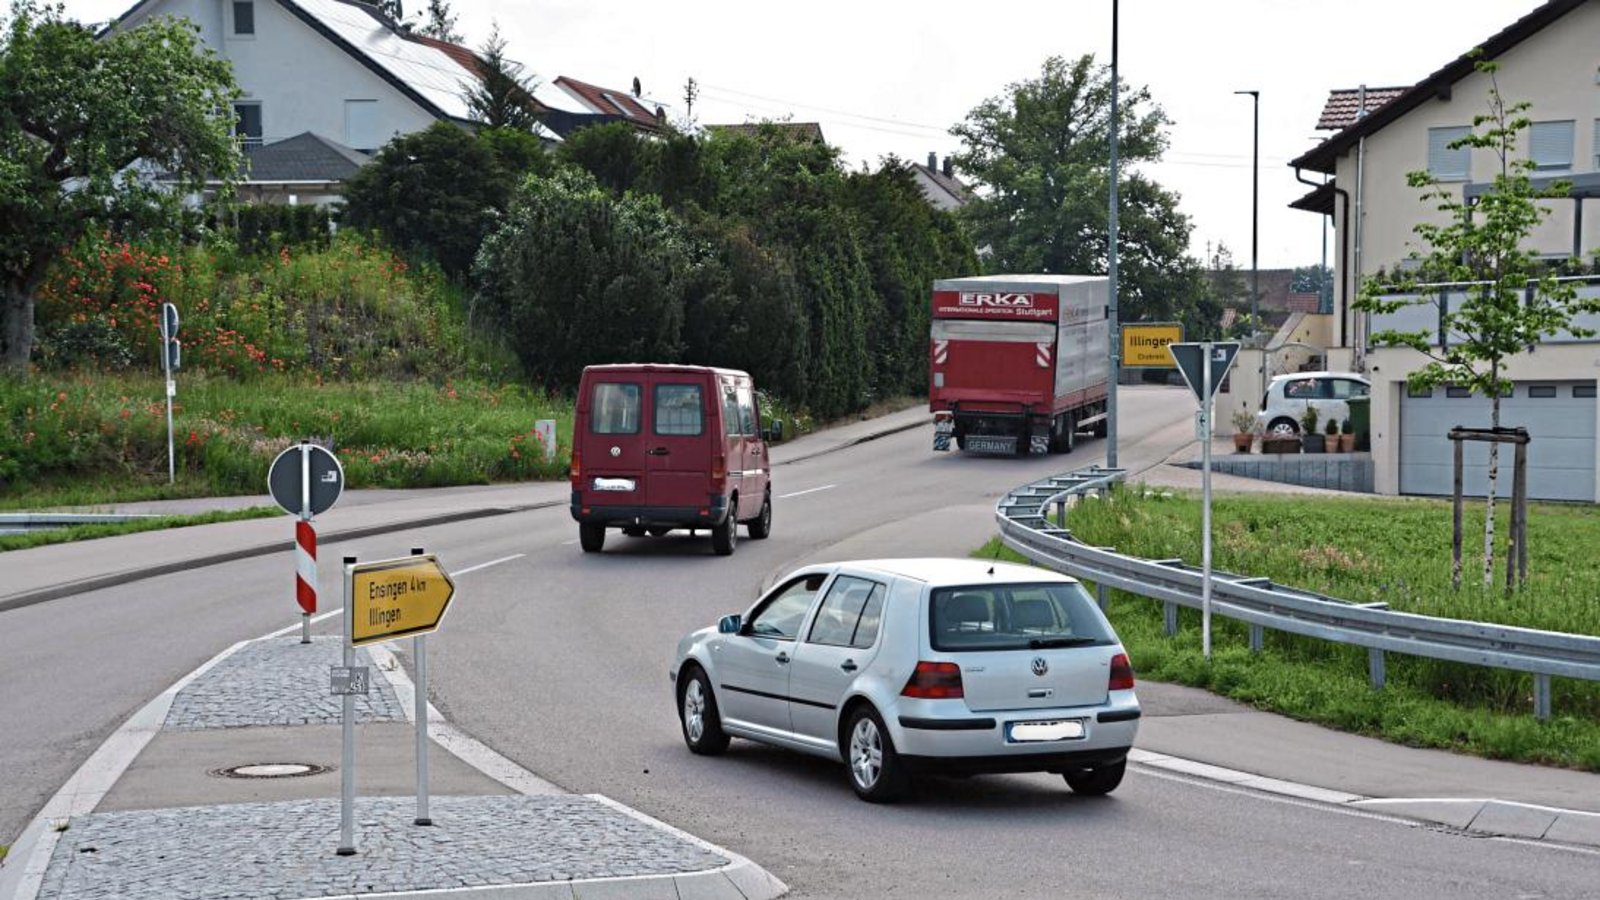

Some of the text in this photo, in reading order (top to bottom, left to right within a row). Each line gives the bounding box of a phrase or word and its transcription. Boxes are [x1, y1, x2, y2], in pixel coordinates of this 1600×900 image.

[961, 293, 1031, 306] ERKA
[1016, 308, 1053, 317] Stuttgart
[1129, 335, 1174, 349] Illingen
[968, 440, 1012, 451] GERMANY
[370, 576, 426, 600] Ensingen 4 km
[369, 608, 401, 628] Illingen
